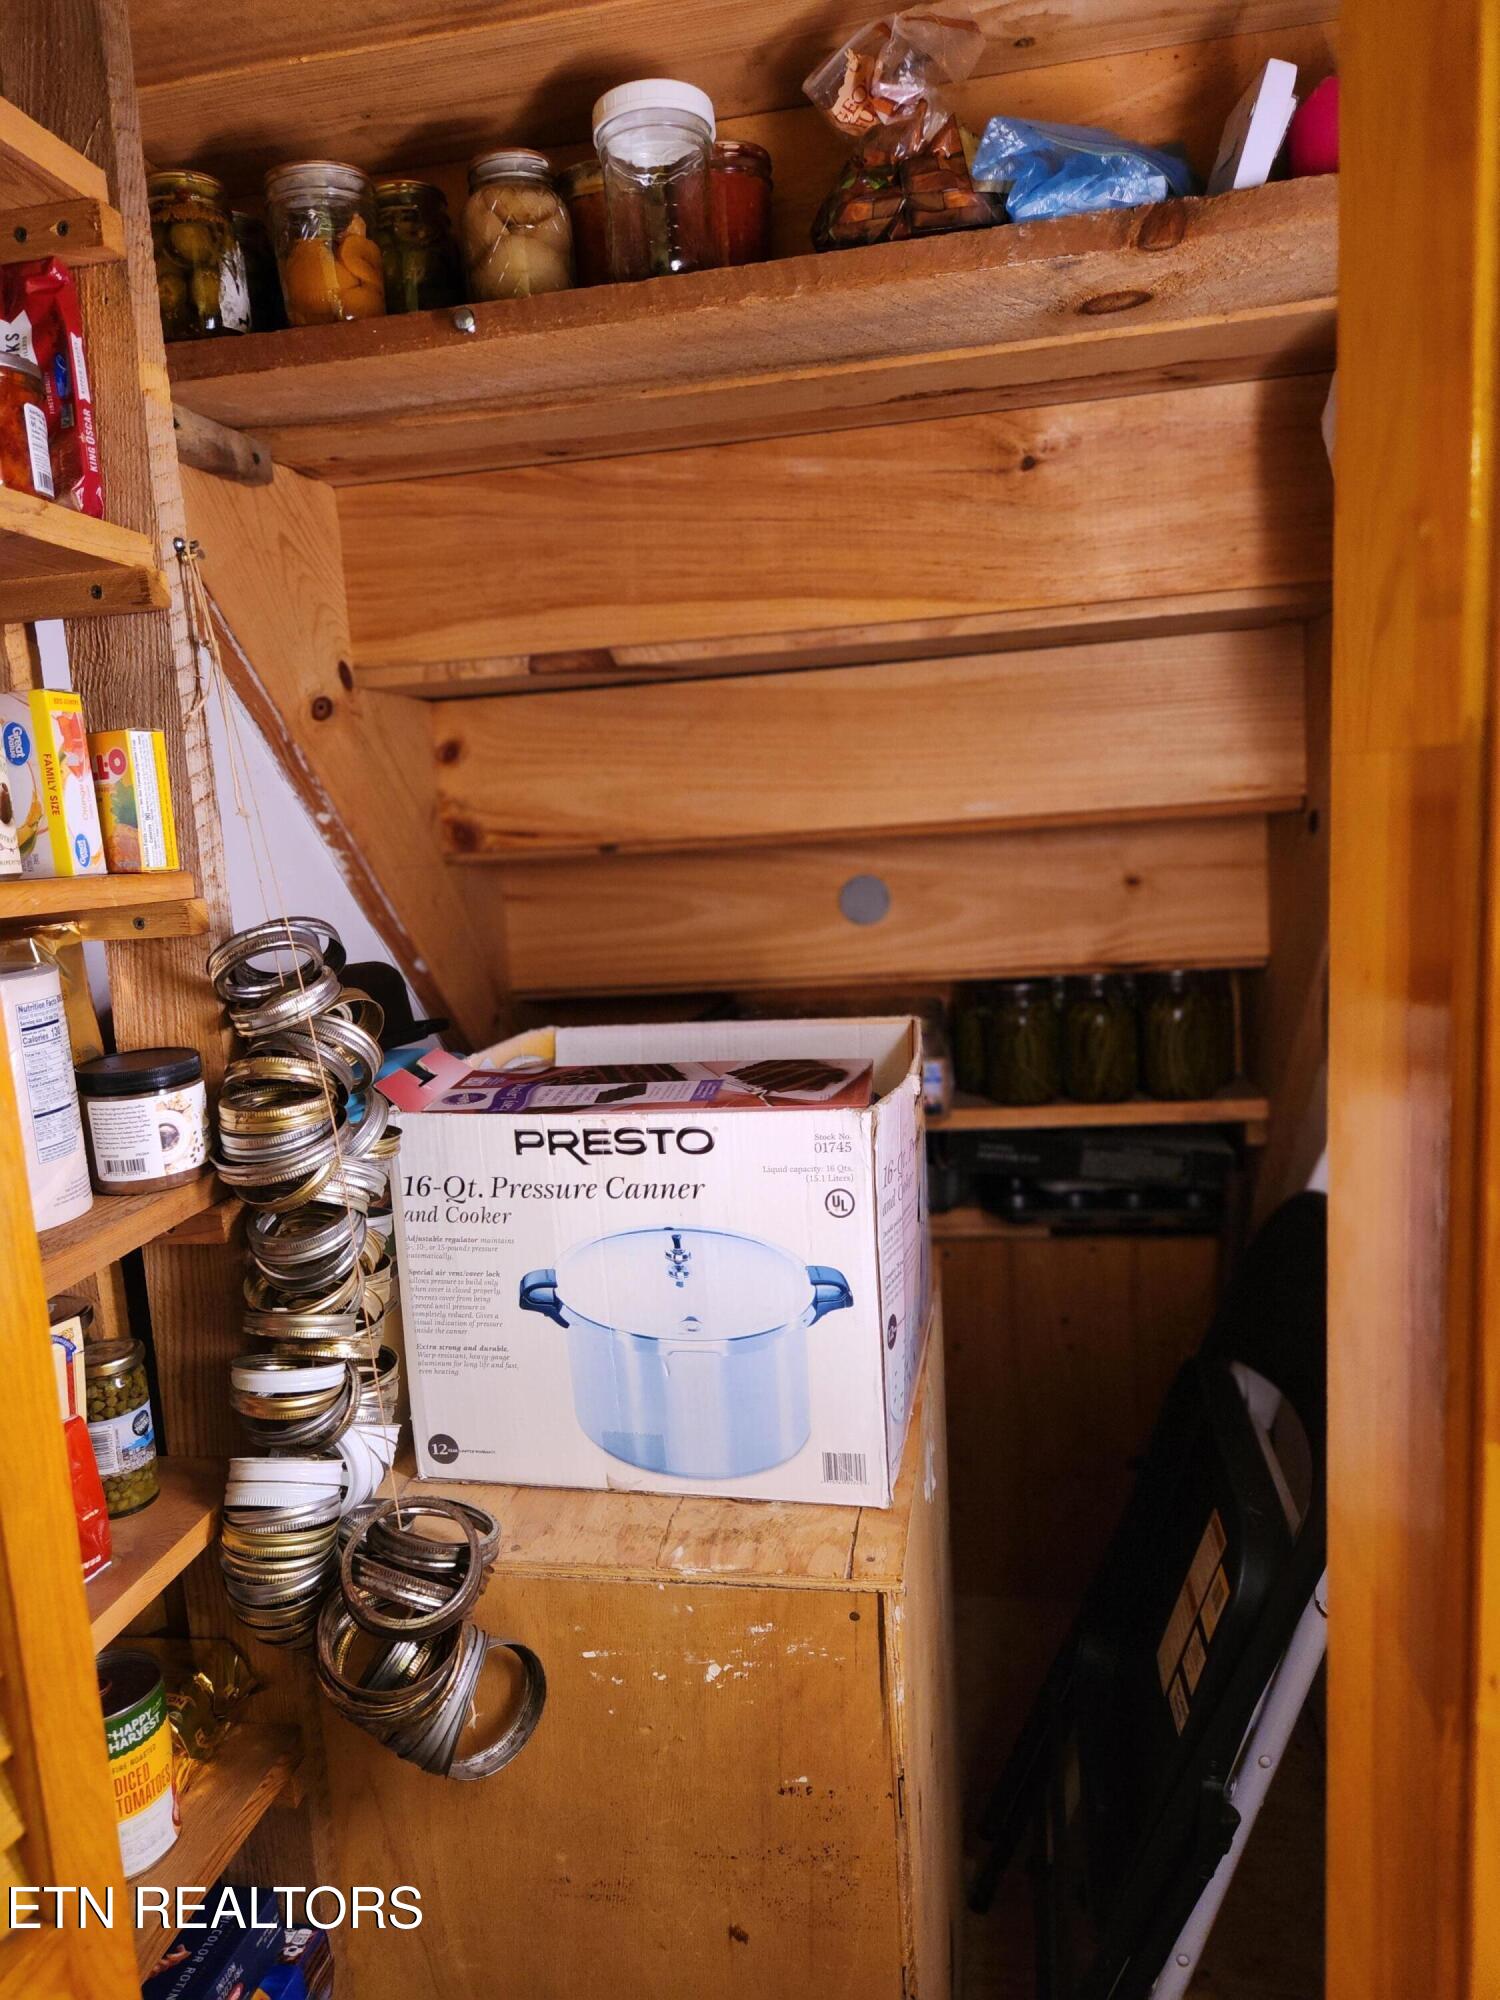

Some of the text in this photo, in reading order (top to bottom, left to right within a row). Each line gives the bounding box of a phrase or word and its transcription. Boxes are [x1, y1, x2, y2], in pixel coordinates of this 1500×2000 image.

[84, 408, 98, 473] KING OSCAR
[8, 734, 17, 759] Value
[12, 726, 26, 759] Great
[43, 752, 61, 817] FAMILY SIZE
[17, 1001, 45, 1013] Nutrition
[22, 1033, 49, 1045] Calories
[814, 1133, 834, 1141] Stock
[514, 1126, 715, 1166] PRESTO
[814, 1141, 852, 1153] 01745
[762, 1165, 788, 1175] Liquid
[789, 1166, 823, 1175] capacity:
[826, 1164, 835, 1173] 16
[827, 1174, 854, 1183] Liters)
[403, 1174, 707, 1203] 16-Qt. Pressure Canner
[403, 1205, 513, 1225] and Cooker
[406, 1234, 515, 1246] Adjustable regulator maintains
[407, 1269, 434, 1278] Special
[435, 1269, 446, 1277] air
[486, 1270, 501, 1278] lock
[430, 1279, 457, 1288] pressure
[465, 1278, 483, 1286] build
[452, 1287, 472, 1295] closed
[455, 1295, 472, 1304] from
[473, 1295, 491, 1304] being
[452, 1303, 478, 1312] pressure
[434, 1320, 467, 1328] indication
[476, 1321, 504, 1330] pressure
[416, 1343, 437, 1351] Extra
[439, 1344, 461, 1353] strong
[463, 1344, 477, 1352] and
[418, 1360, 452, 1368] aluminum
[463, 1361, 478, 1370] long
[491, 1362, 504, 1370] and
[431, 1443, 449, 1455] 12
[112, 1707, 153, 1741] HAPPY
[109, 1711, 161, 1754] HARVEST
[113, 1762, 151, 1798] DICED
[116, 1763, 171, 1818] TOMATOES
